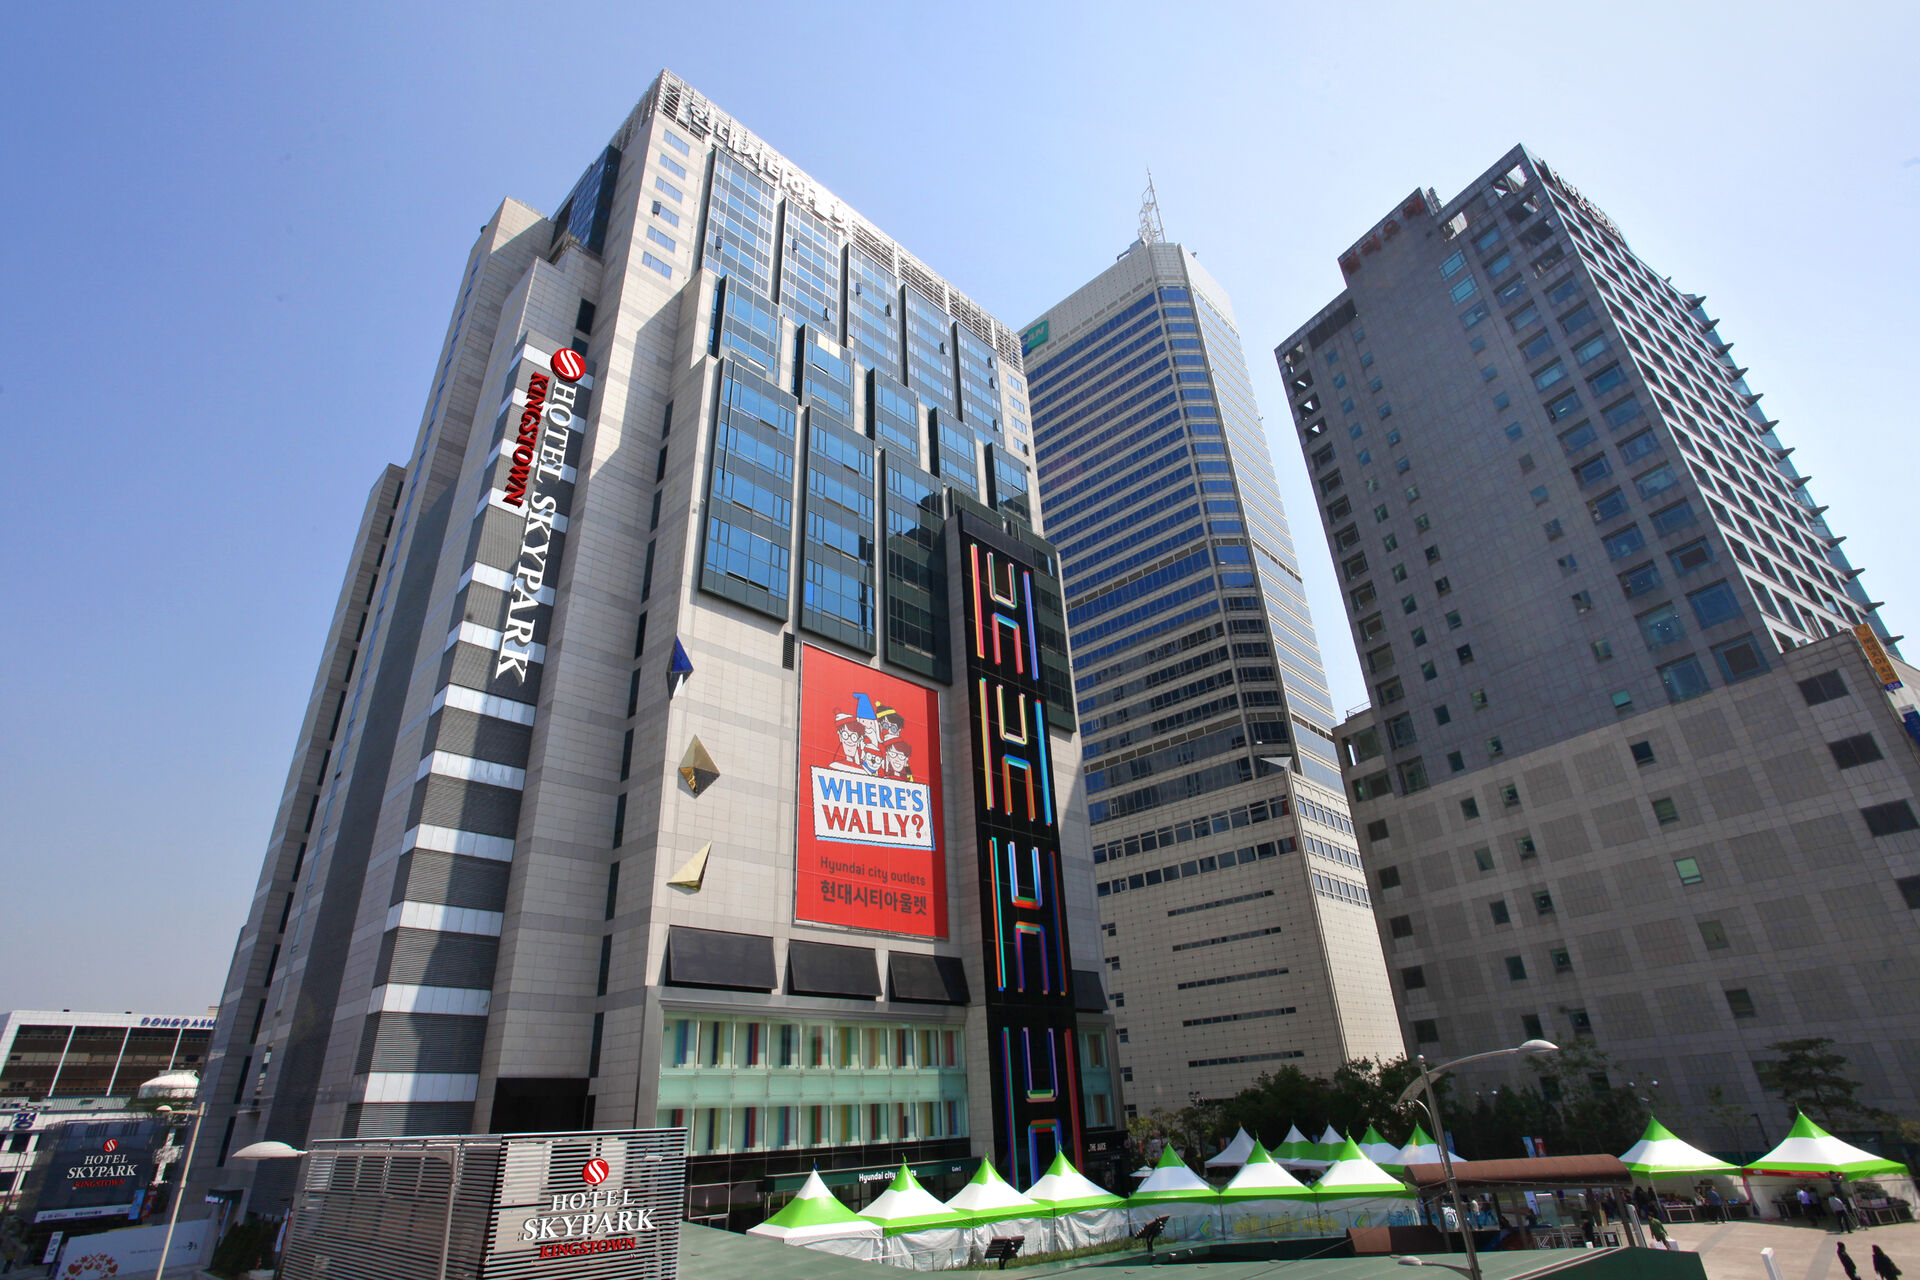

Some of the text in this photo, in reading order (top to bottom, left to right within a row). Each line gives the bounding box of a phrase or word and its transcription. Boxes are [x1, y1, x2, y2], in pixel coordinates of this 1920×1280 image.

[1341, 195, 1425, 275] 밀리오레
[502, 370, 550, 509] KINGSTOWN
[495, 379, 578, 684] HOTEL SKYPARK
[818, 775, 924, 812] WHERE'S
[822, 804, 924, 839] WALLY?
[820, 856, 926, 886] Hyundai city outlets
[820, 879, 927, 916] 현대시티아울렛
[67, 1164, 139, 1179] SKYPARK
[84, 1154, 129, 1165] HOTEL
[74, 1178, 126, 1188] KINGSTOWN
[858, 1171, 884, 1184] Hyundai
[884, 1170, 896, 1182] city
[551, 1188, 636, 1212] HOTEL
[522, 1207, 658, 1242] SKYPARK
[538, 1237, 638, 1259] KINGSTOWN
